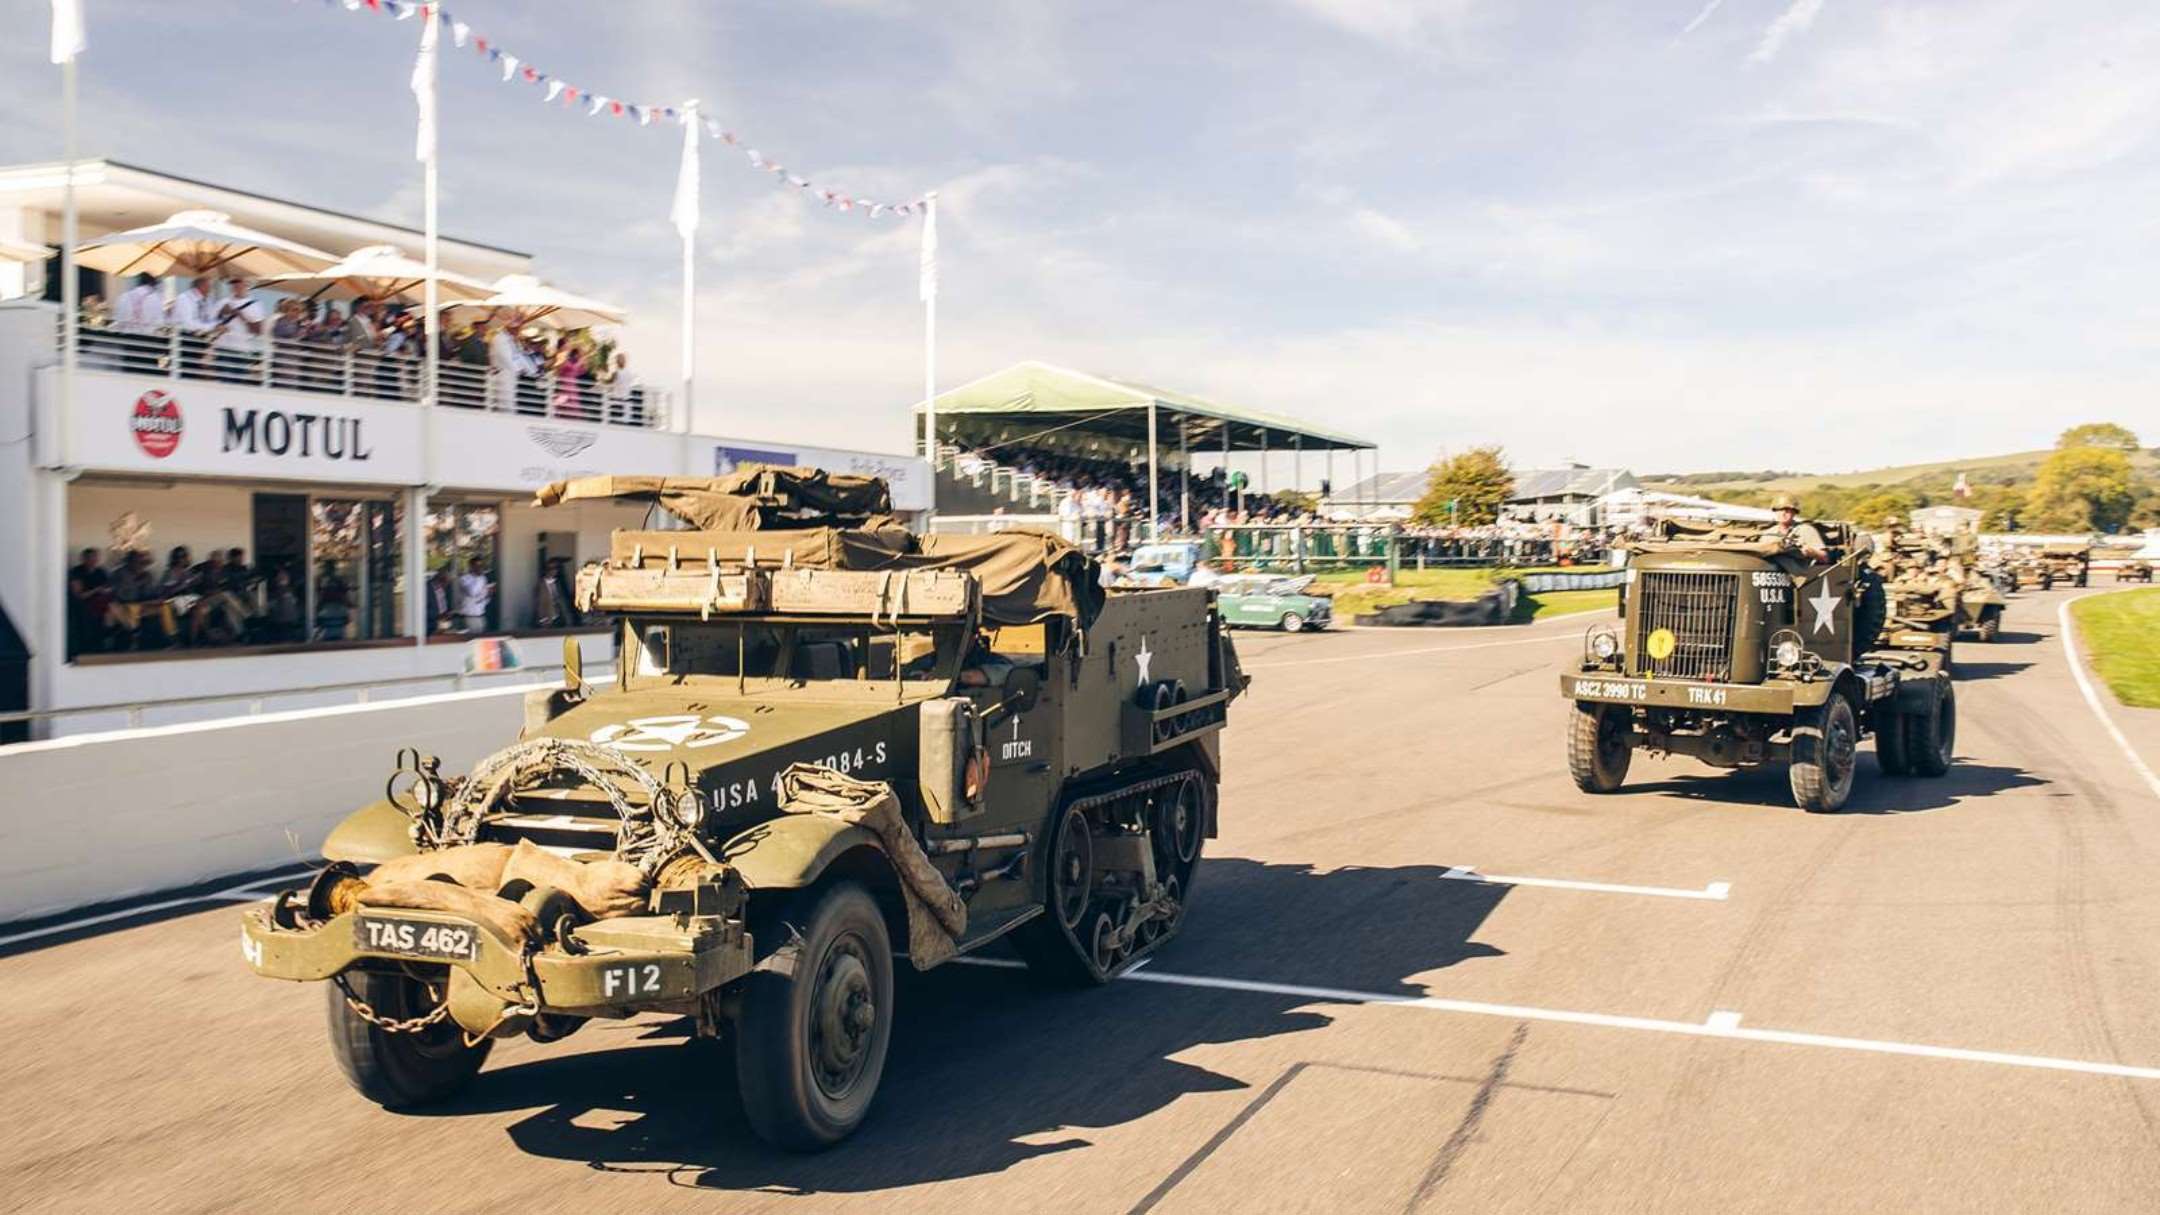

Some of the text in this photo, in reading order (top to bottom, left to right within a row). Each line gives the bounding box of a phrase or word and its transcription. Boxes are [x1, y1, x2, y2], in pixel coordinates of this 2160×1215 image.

[221, 408, 373, 460] MOTUL
[1574, 680, 1602, 697] ASCZ
[1631, 684, 1647, 700] TC
[1002, 740, 1031, 760] DITCH
[713, 778, 758, 812] USA
[365, 921, 469, 954] TAS 462
